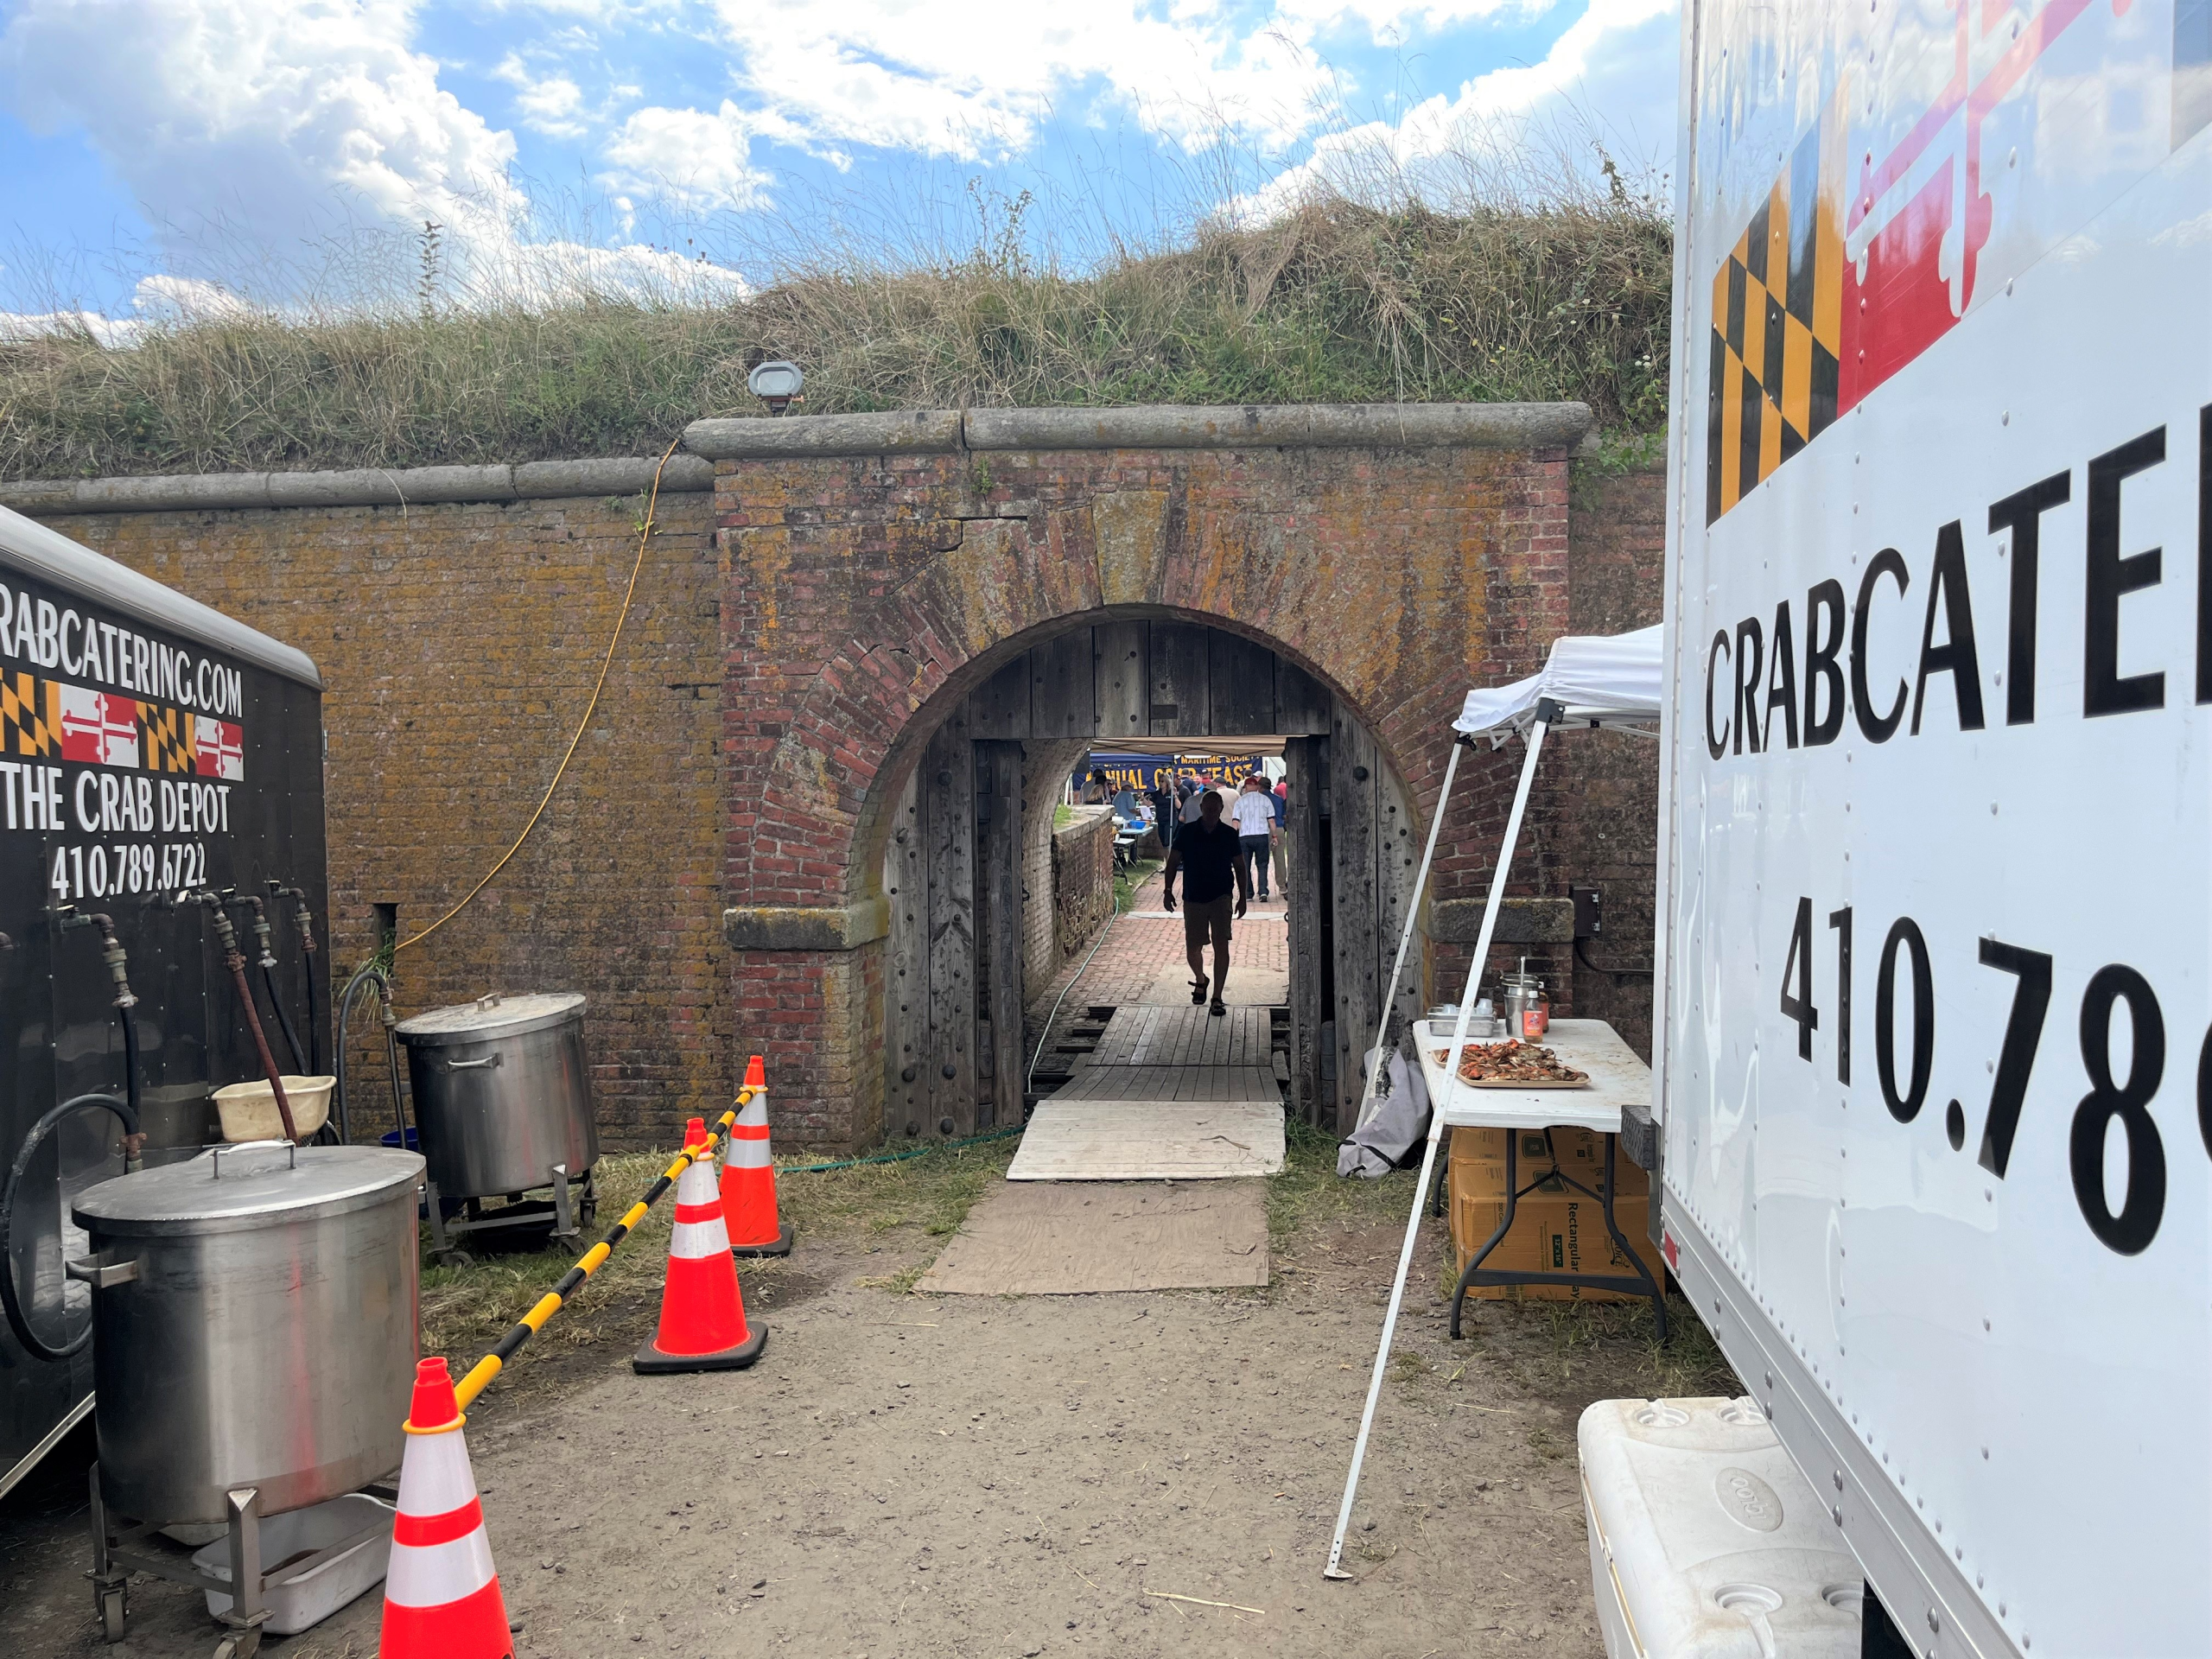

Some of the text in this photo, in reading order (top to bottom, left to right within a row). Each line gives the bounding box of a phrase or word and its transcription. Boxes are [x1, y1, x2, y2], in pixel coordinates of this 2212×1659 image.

[1705, 402, 2212, 762] CRABCATE
[0, 761, 230, 833] THE CRAB DEPOT
[52, 842, 207, 899] 410.789.6722
[1780, 896, 2212, 1256] 410.78
[1568, 1202, 1581, 1272] Rectangular
